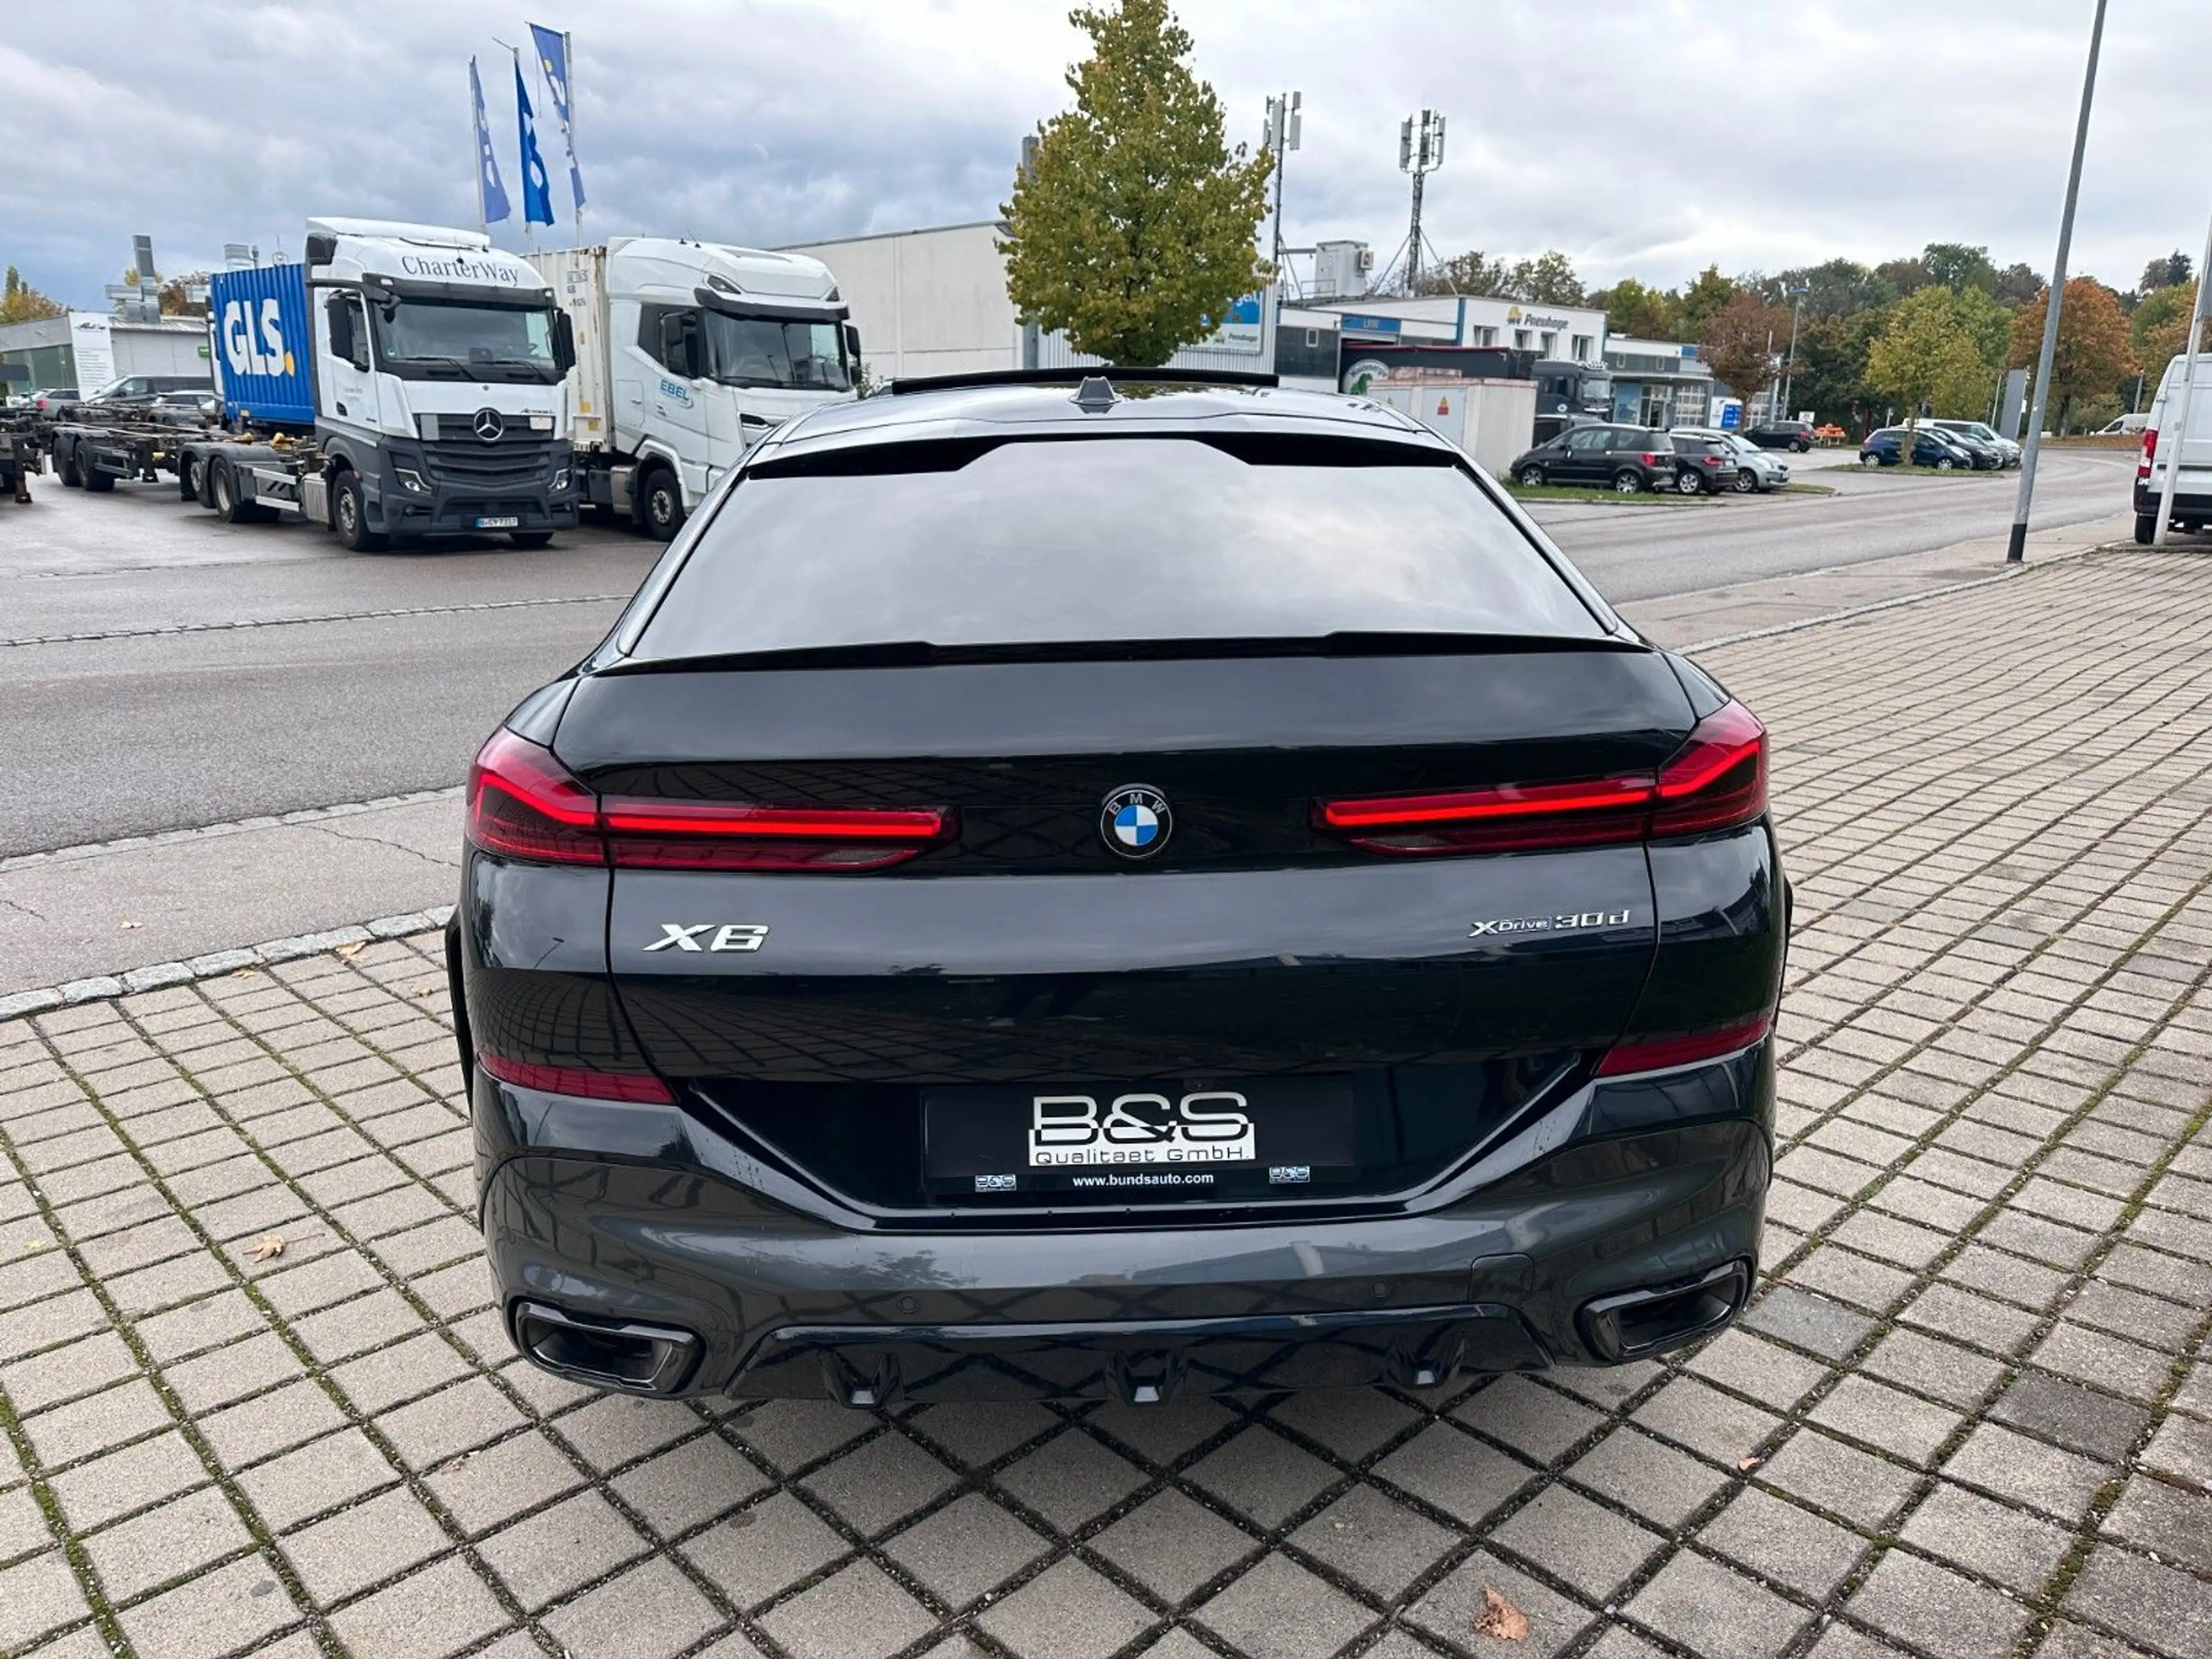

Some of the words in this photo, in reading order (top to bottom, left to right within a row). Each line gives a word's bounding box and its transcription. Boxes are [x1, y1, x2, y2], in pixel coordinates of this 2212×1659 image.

[402, 256, 518, 287] CharterWay
[660, 379, 690, 402] EBEL
[1107, 793, 1166, 816] BMW
[641, 923, 769, 952] X6
[1033, 1092, 1248, 1146] B&S
[1035, 1149, 1155, 1164] Qualitaet
[1073, 1173, 1214, 1187] www.bundsauto.com
